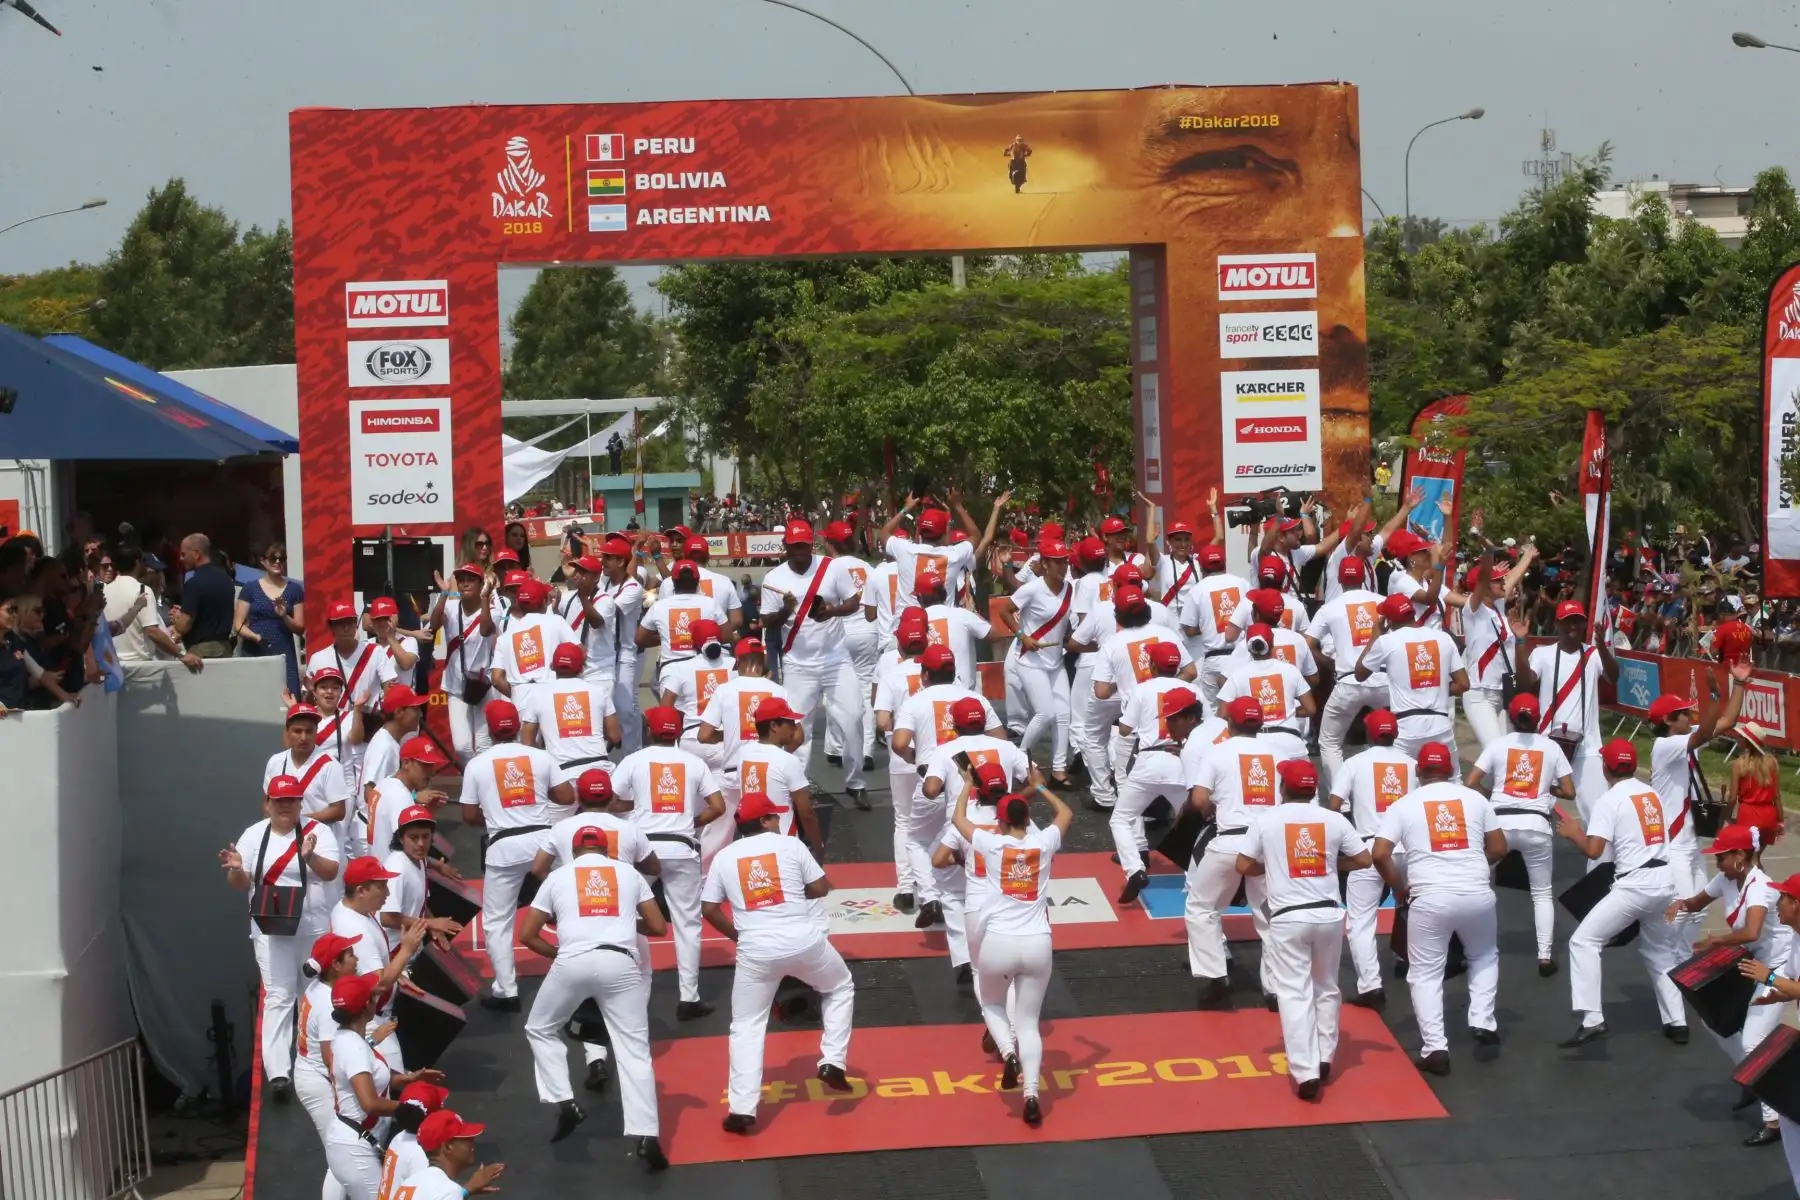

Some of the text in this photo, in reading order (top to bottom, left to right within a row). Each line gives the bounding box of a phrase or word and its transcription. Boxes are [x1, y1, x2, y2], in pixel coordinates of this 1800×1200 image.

[1179, 114, 1280, 129] #Dakar2018
[633, 137, 696, 155] PERU
[635, 171, 727, 190] BOLIVIA
[491, 191, 553, 219] DAKAR
[636, 205, 771, 225] ARGENTINA
[503, 221, 544, 235] 2018
[1224, 266, 1311, 288] MOTUL
[352, 293, 442, 315] MOTUL
[1226, 332, 1259, 344] sport
[379, 350, 418, 368] FOX
[379, 367, 419, 376] SPORTS
[1235, 381, 1305, 395] KÄRCHER
[367, 416, 433, 426] HIMOINSA
[1254, 425, 1303, 435] HONDA
[364, 452, 438, 467] TOYOTA
[1235, 464, 1310, 476] BFGoodrich
[367, 489, 439, 506] sodexo
[751, 541, 783, 552] sodex
